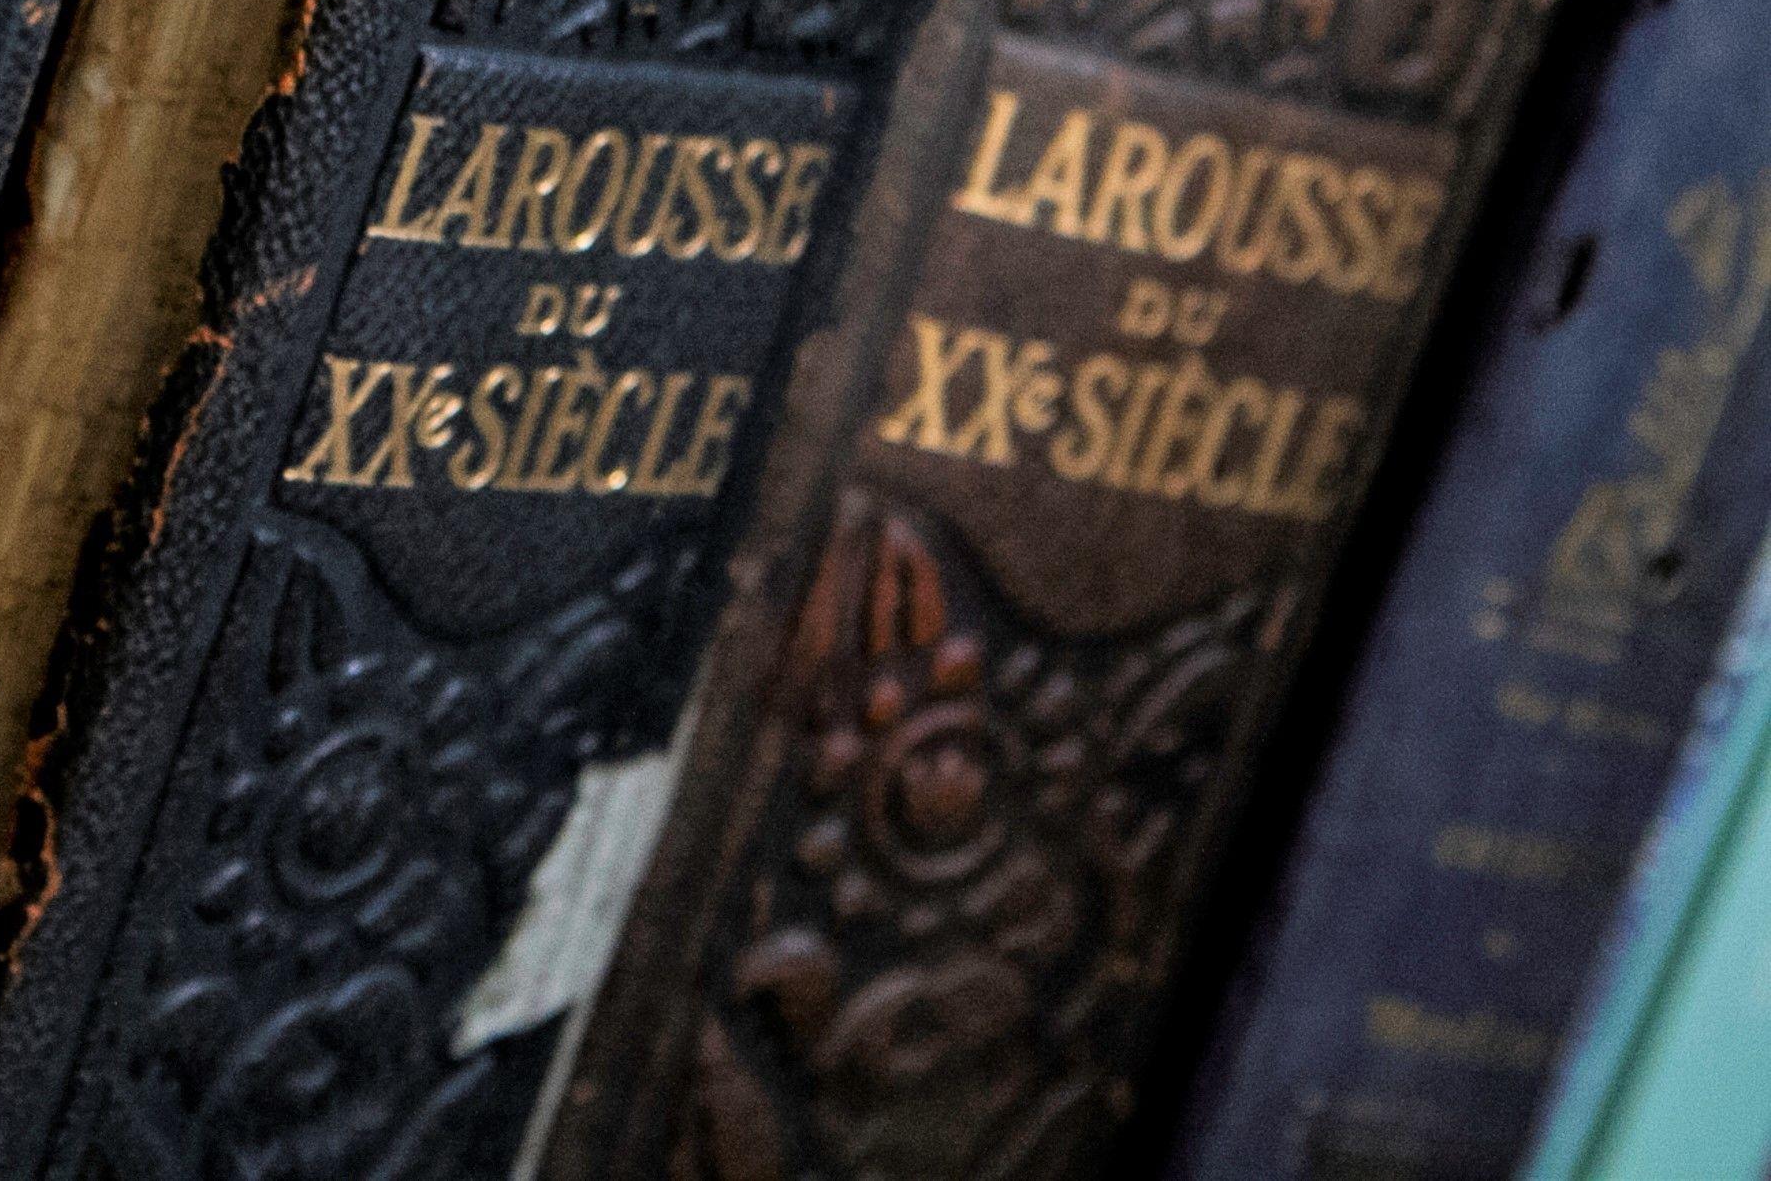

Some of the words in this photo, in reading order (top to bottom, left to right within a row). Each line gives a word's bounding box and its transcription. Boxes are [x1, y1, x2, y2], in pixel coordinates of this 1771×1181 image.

[366, 114, 829, 265] LAROUSSE
[949, 89, 1444, 305] LAROUSSE
[516, 283, 623, 338] DU
[1120, 276, 1230, 345] DU
[282, 353, 462, 489] XXe
[447, 346, 754, 498] SIÈCLE
